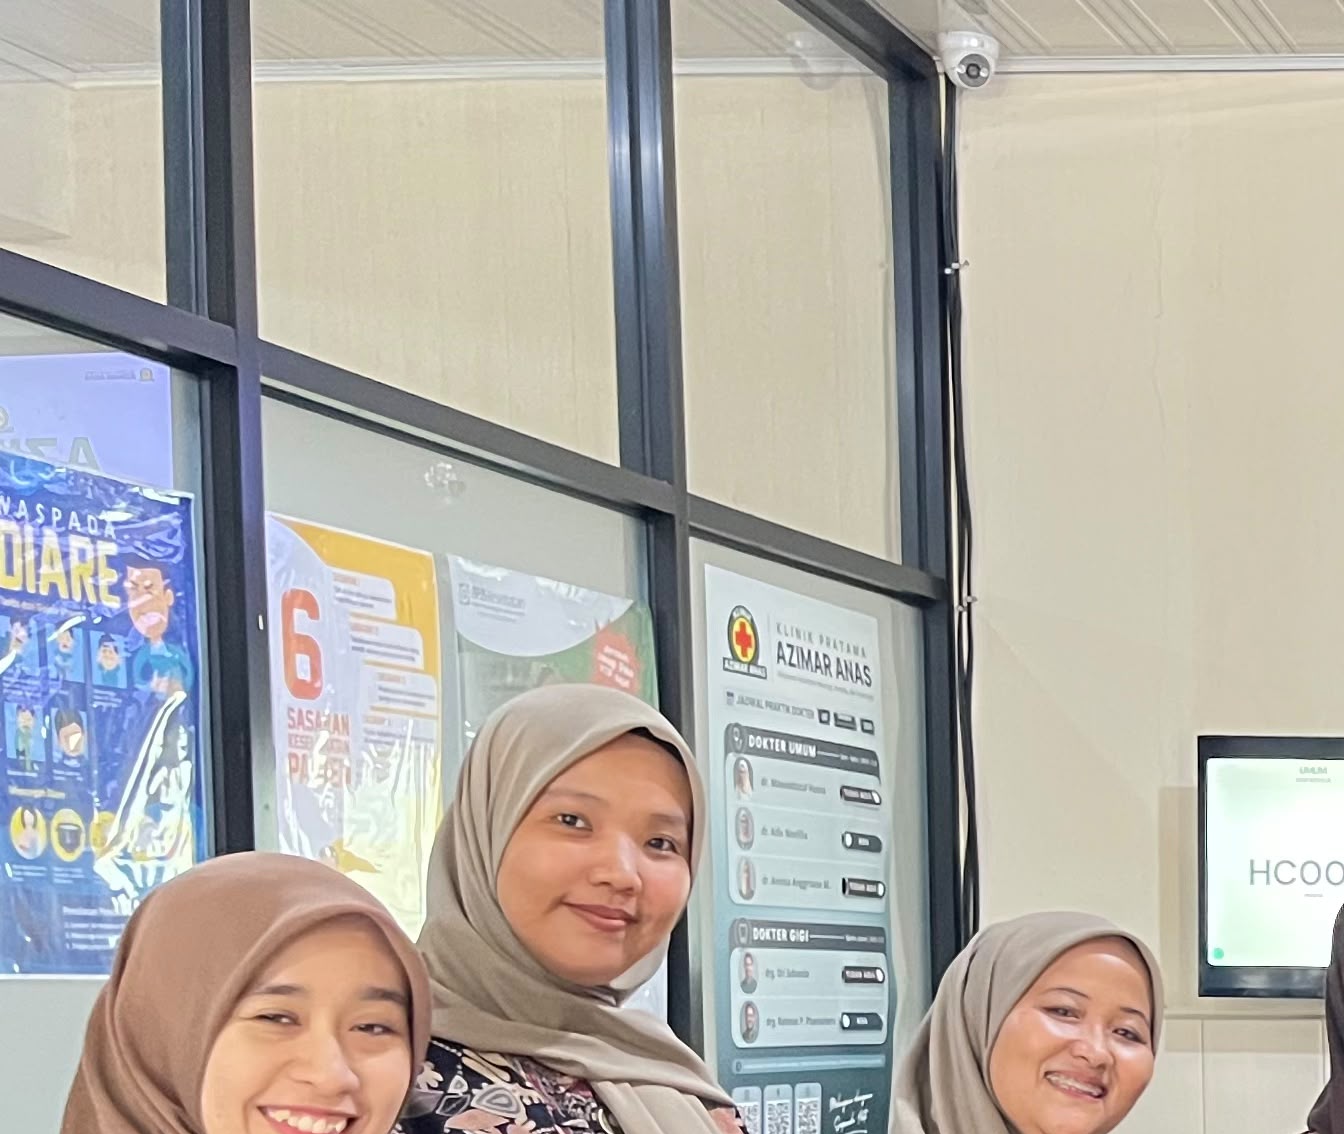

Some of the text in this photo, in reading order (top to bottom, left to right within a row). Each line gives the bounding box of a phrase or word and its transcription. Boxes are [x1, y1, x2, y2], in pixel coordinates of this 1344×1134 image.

[0, 518, 121, 609] DIARE
[281, 588, 324, 700] 6
[776, 622, 867, 659] KLINIK PRATAMA
[776, 641, 833, 678] AZIMAR
[835, 658, 873, 688] ANAS
[748, 734, 817, 758] DOKTER UMUM
[753, 927, 809, 942] DOKTER GIGI
